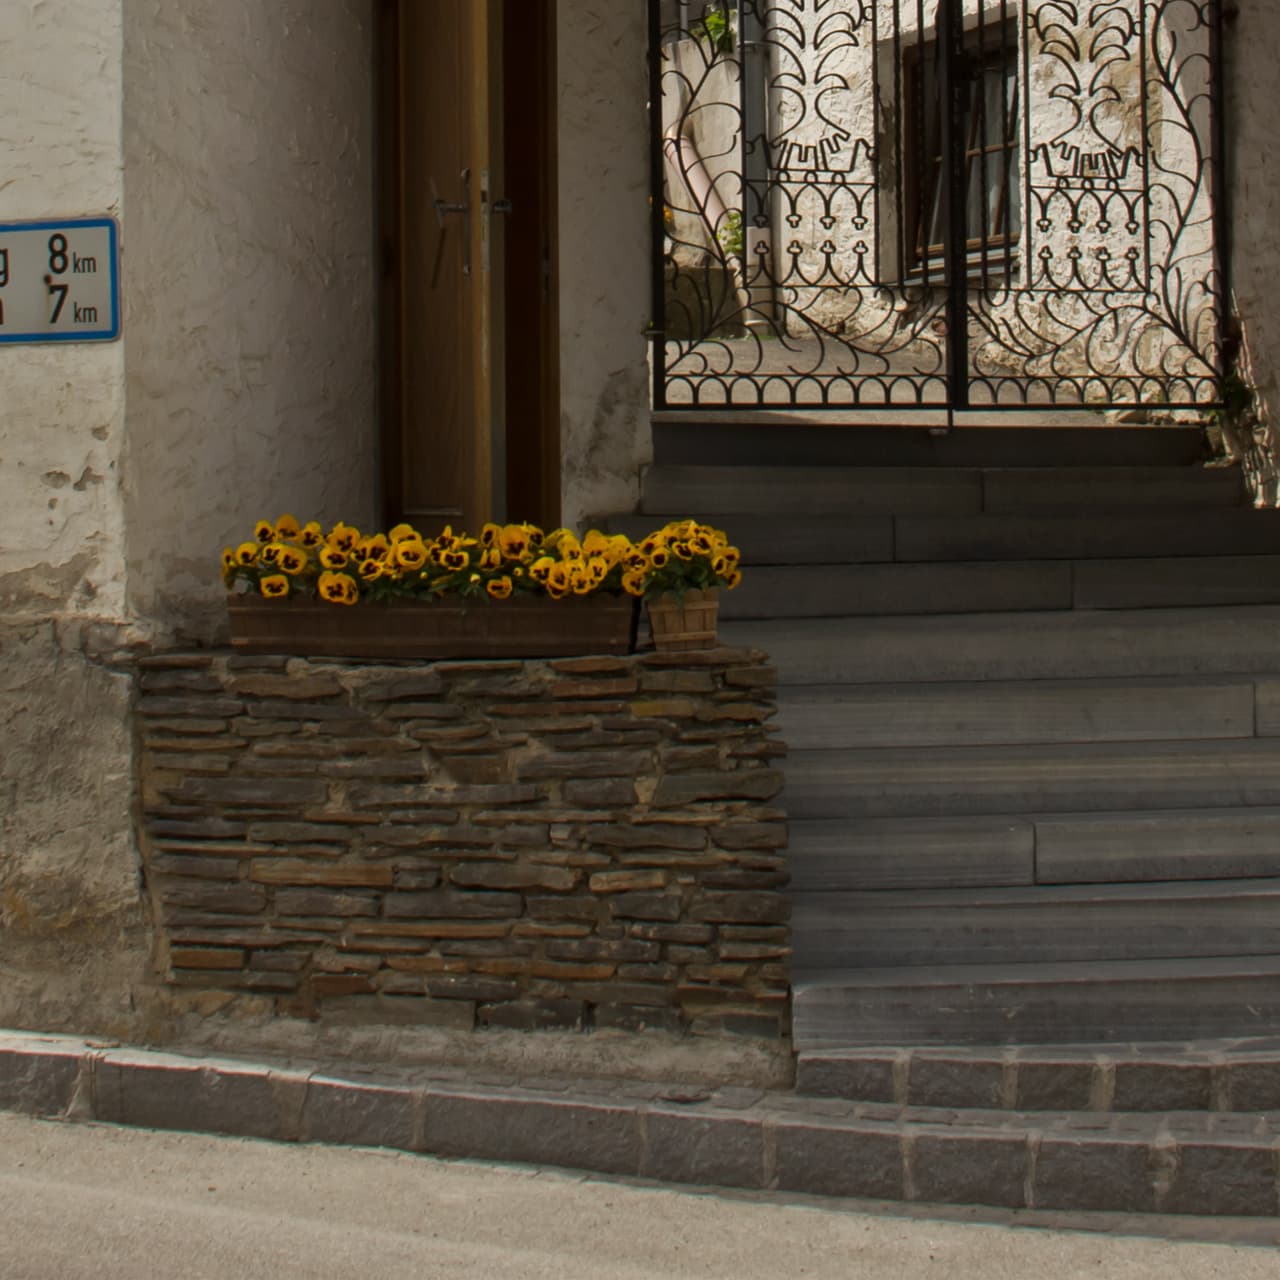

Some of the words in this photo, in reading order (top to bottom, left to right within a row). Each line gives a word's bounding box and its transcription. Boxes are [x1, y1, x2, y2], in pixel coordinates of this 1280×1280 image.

[48, 233, 69, 274] 8
[72, 251, 97, 273] km
[48, 284, 69, 324] 7
[73, 301, 98, 323] km
